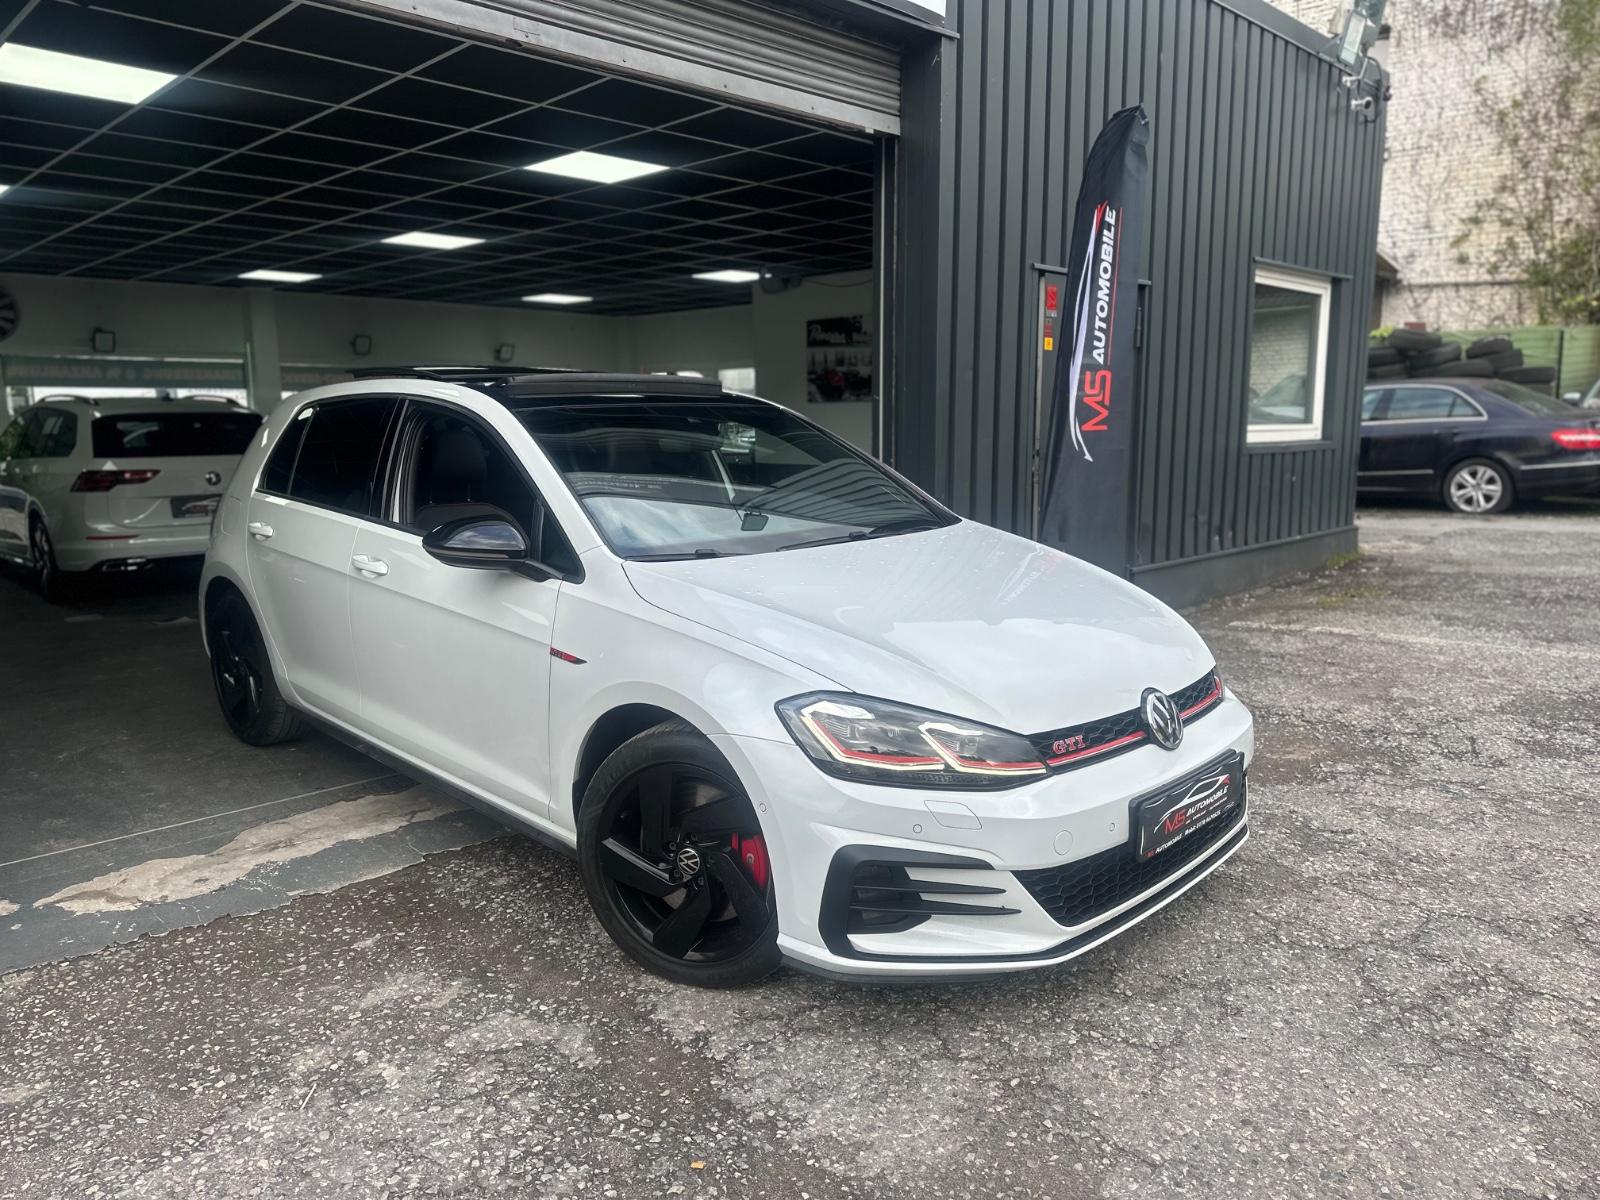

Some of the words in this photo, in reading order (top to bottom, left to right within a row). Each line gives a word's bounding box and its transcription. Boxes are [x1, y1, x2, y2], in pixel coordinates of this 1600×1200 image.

[1092, 205, 1117, 365] AUTOMOBILE
[1081, 369, 1112, 431] MS
[1052, 734, 1085, 755] GTI
[1164, 808, 1187, 835] MS
[1186, 785, 1229, 817] AUTOMOBILE
